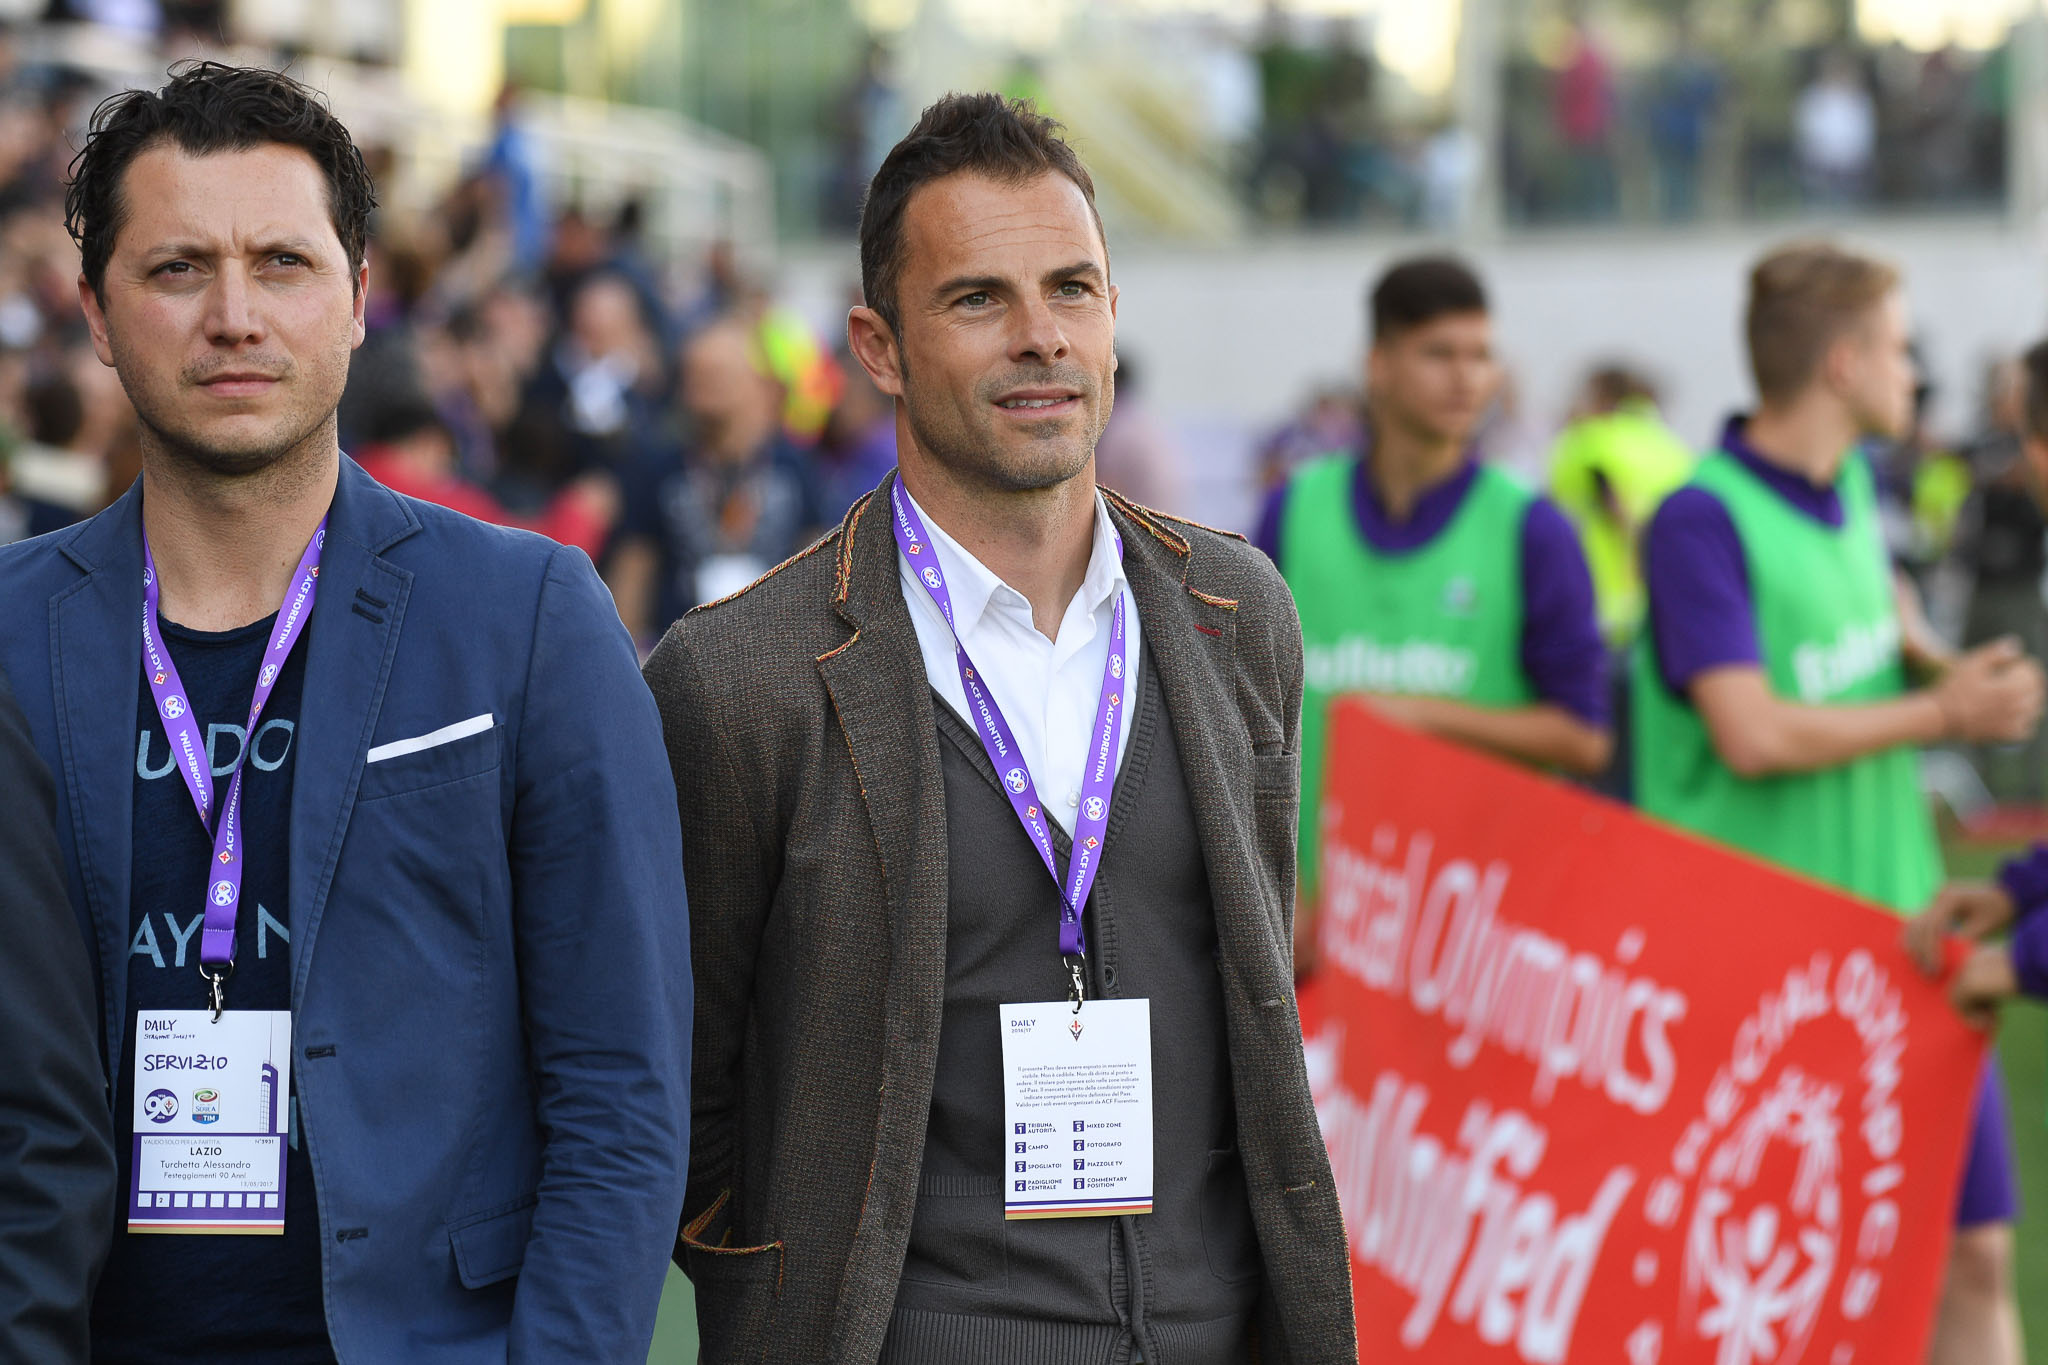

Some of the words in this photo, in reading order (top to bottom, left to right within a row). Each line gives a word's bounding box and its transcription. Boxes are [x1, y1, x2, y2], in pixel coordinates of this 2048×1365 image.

[903, 526, 918, 542] ACF
[299, 574, 313, 594] ACF
[275, 592, 306, 650] FIORENTINA
[151, 653, 164, 671] ACF
[969, 681, 982, 699] ACF
[977, 695, 1008, 758] FIORENTINA
[1107, 704, 1120, 724] ACF
[179, 730, 203, 788] FIORENTINA
[1095, 723, 1113, 783] FIORENTINA
[199, 787, 209, 809] ACF
[1030, 820, 1045, 839] ACF
[226, 831, 234, 851] ACF
[1079, 849, 1091, 869] ACF
[1071, 869, 1086, 909] FIORENT
[1409, 857, 1689, 1115] Olympics
[145, 1019, 177, 1032] DAILY
[1011, 1019, 1036, 1027] DAILY
[144, 1054, 228, 1072] SERVIZIO
[190, 1147, 222, 1156] LAZIO
[160, 1160, 200, 1169] Turchetta
[203, 1160, 251, 1169] Alessandro
[163, 1171, 217, 1180] Festeggiamenti
